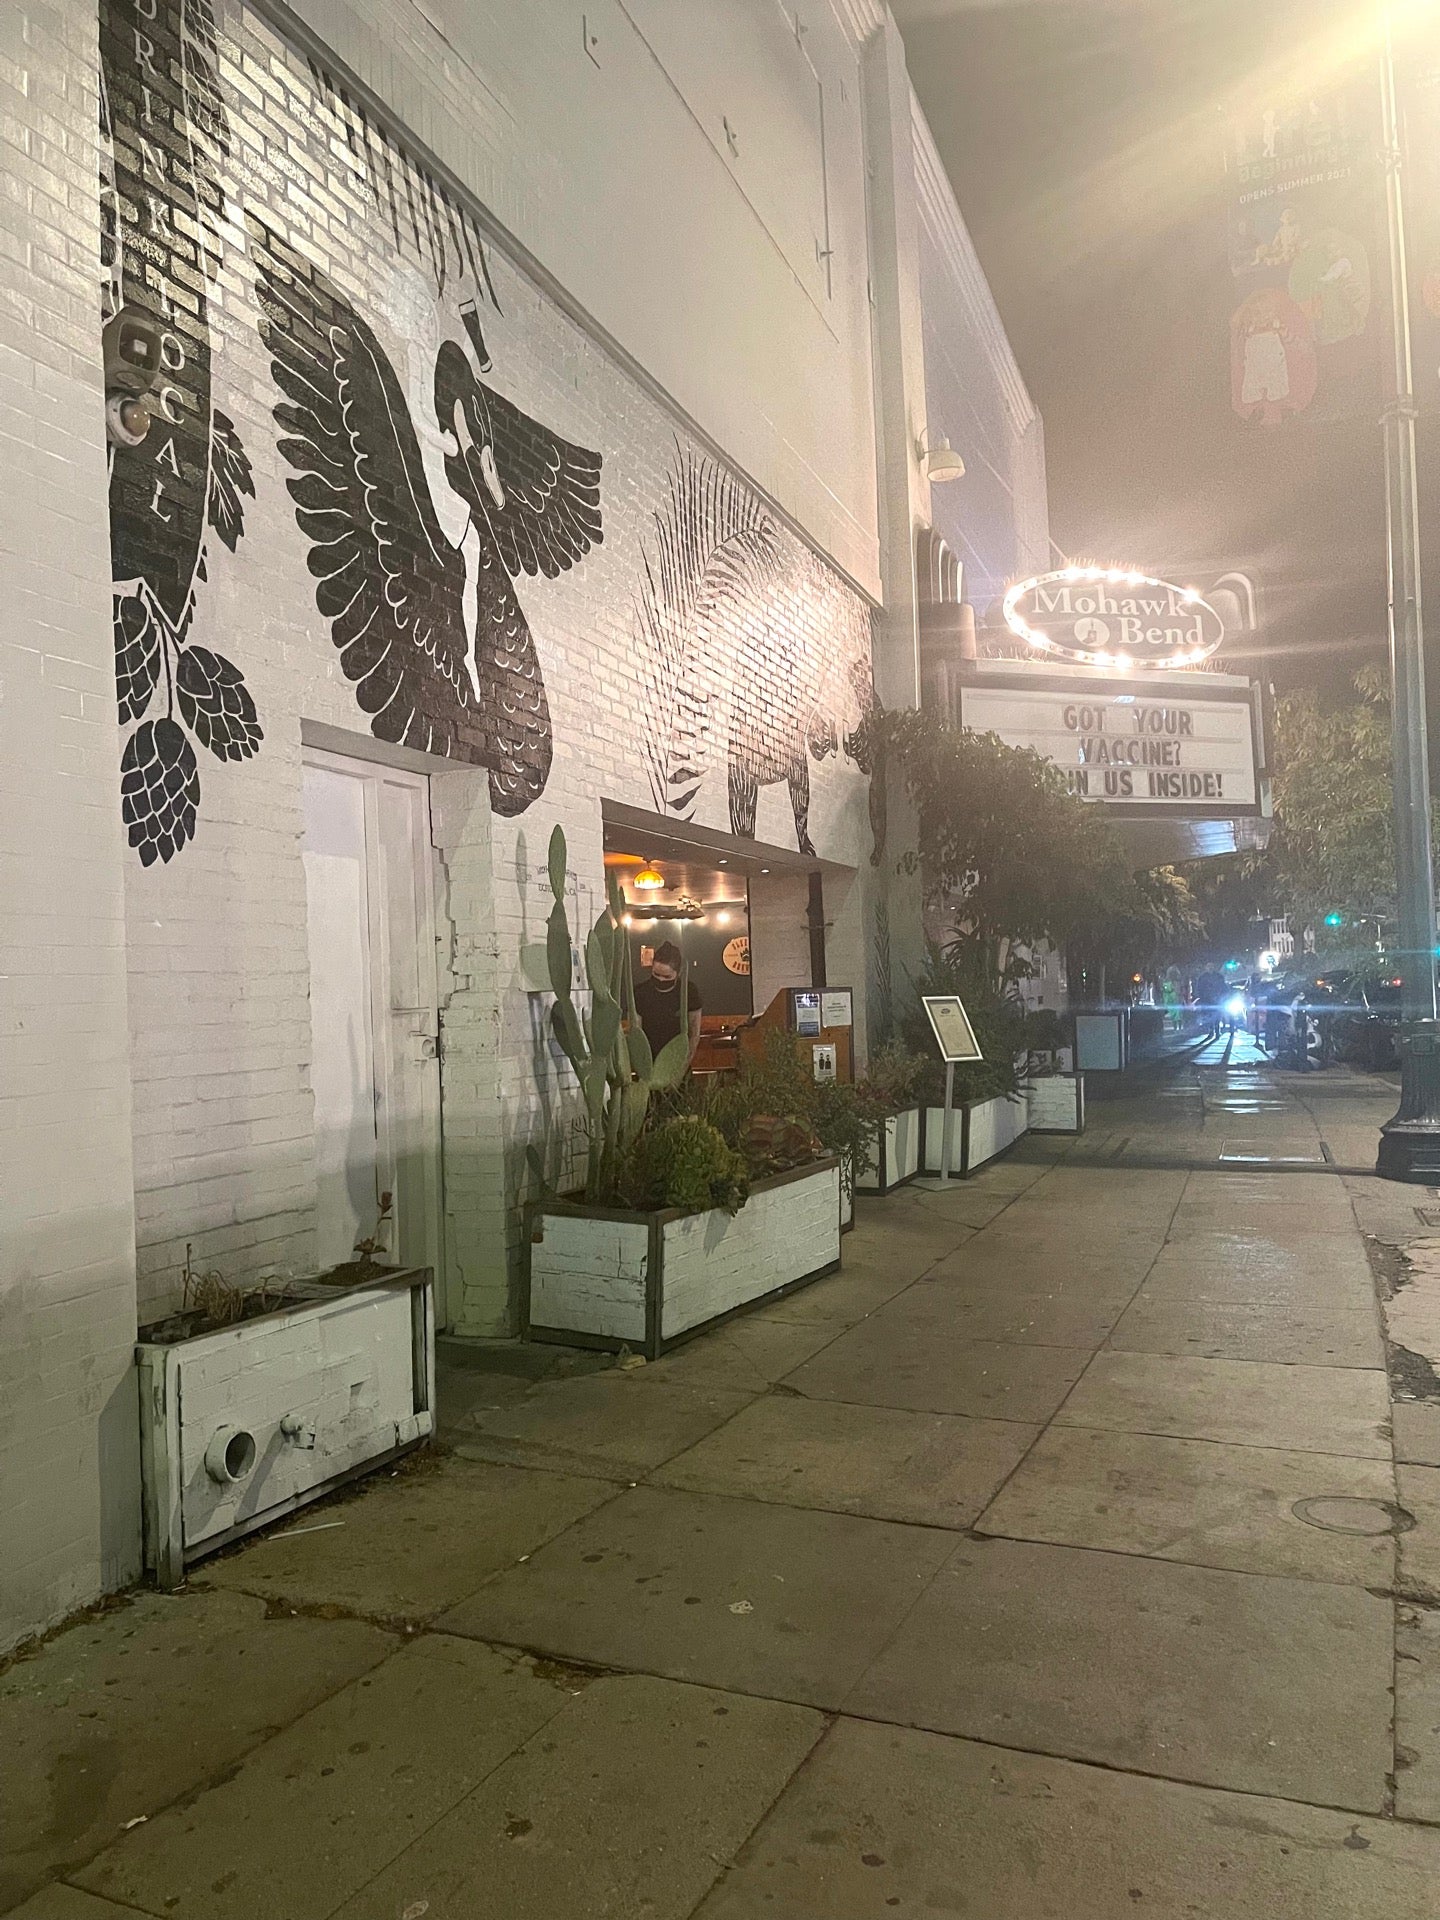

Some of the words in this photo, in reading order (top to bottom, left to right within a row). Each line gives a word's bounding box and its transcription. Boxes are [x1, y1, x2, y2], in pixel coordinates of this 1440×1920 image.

[1239, 185, 1275, 205] OPENS
[1276, 174, 1324, 194] SUMMER
[1326, 166, 1352, 181] 2021
[149, 277, 186, 522] LOCAL
[1032, 583, 1190, 617] Mohawk
[1118, 615, 1206, 645] Bend
[1063, 704, 1106, 731] GOT
[1133, 707, 1193, 736] YOUR
[1080, 738, 1182, 767] VACCINE?
[1104, 770, 1134, 796] US
[1148, 773, 1223, 798] INSIDE!
